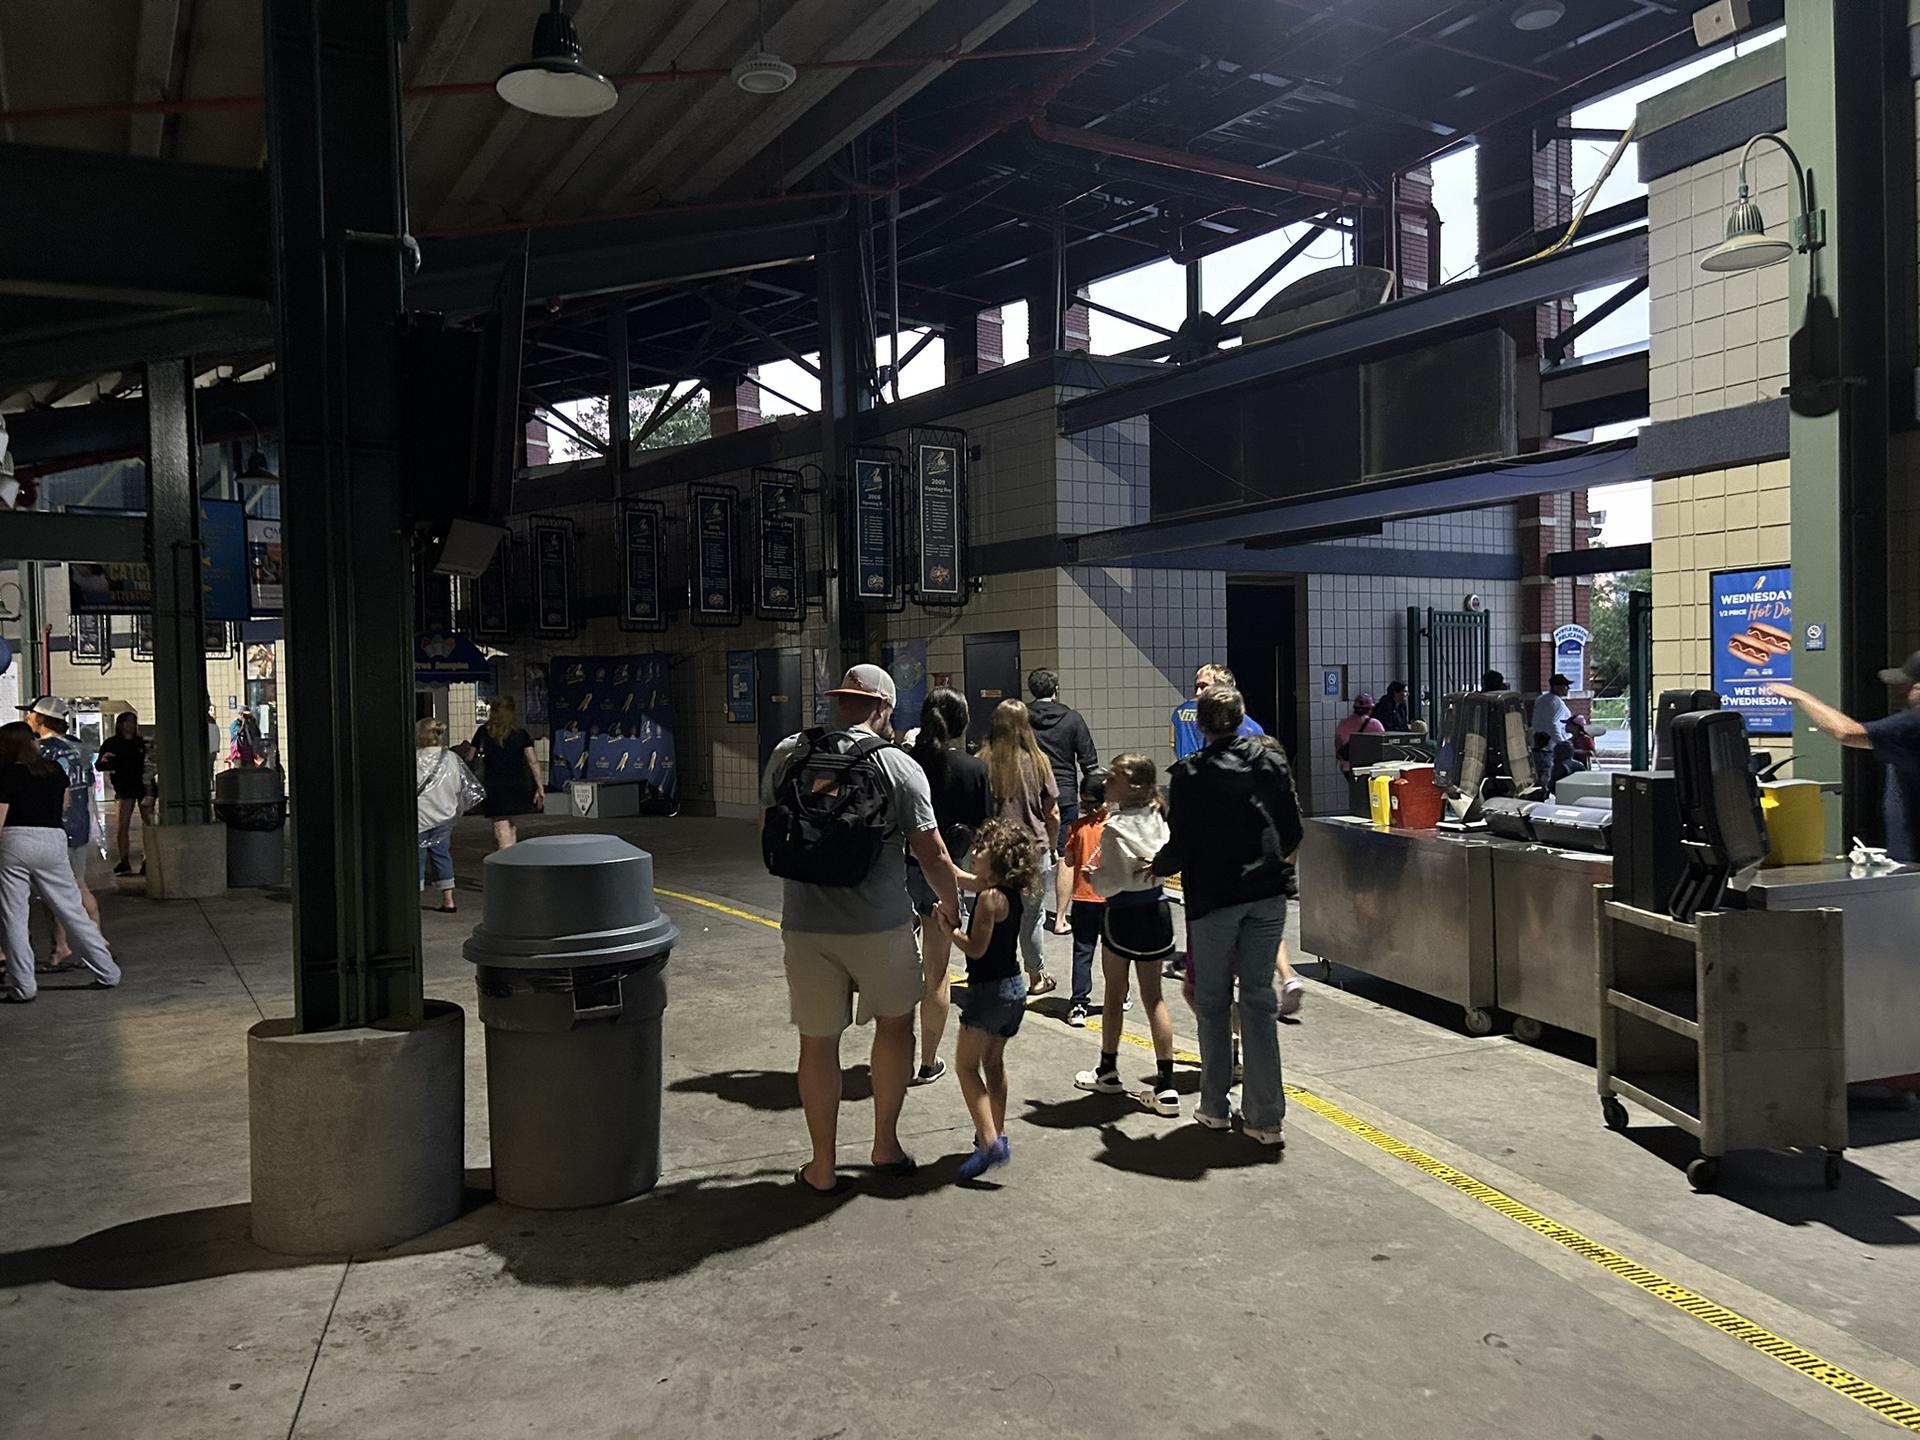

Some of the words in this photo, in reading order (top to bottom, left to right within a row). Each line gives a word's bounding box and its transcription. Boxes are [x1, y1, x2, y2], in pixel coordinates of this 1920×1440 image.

[1721, 590, 1792, 605] WEDNESDAY
[1747, 603, 1774, 621] Hot
[1557, 632, 1584, 642] PELICANS
[1734, 687, 1757, 696] WET
